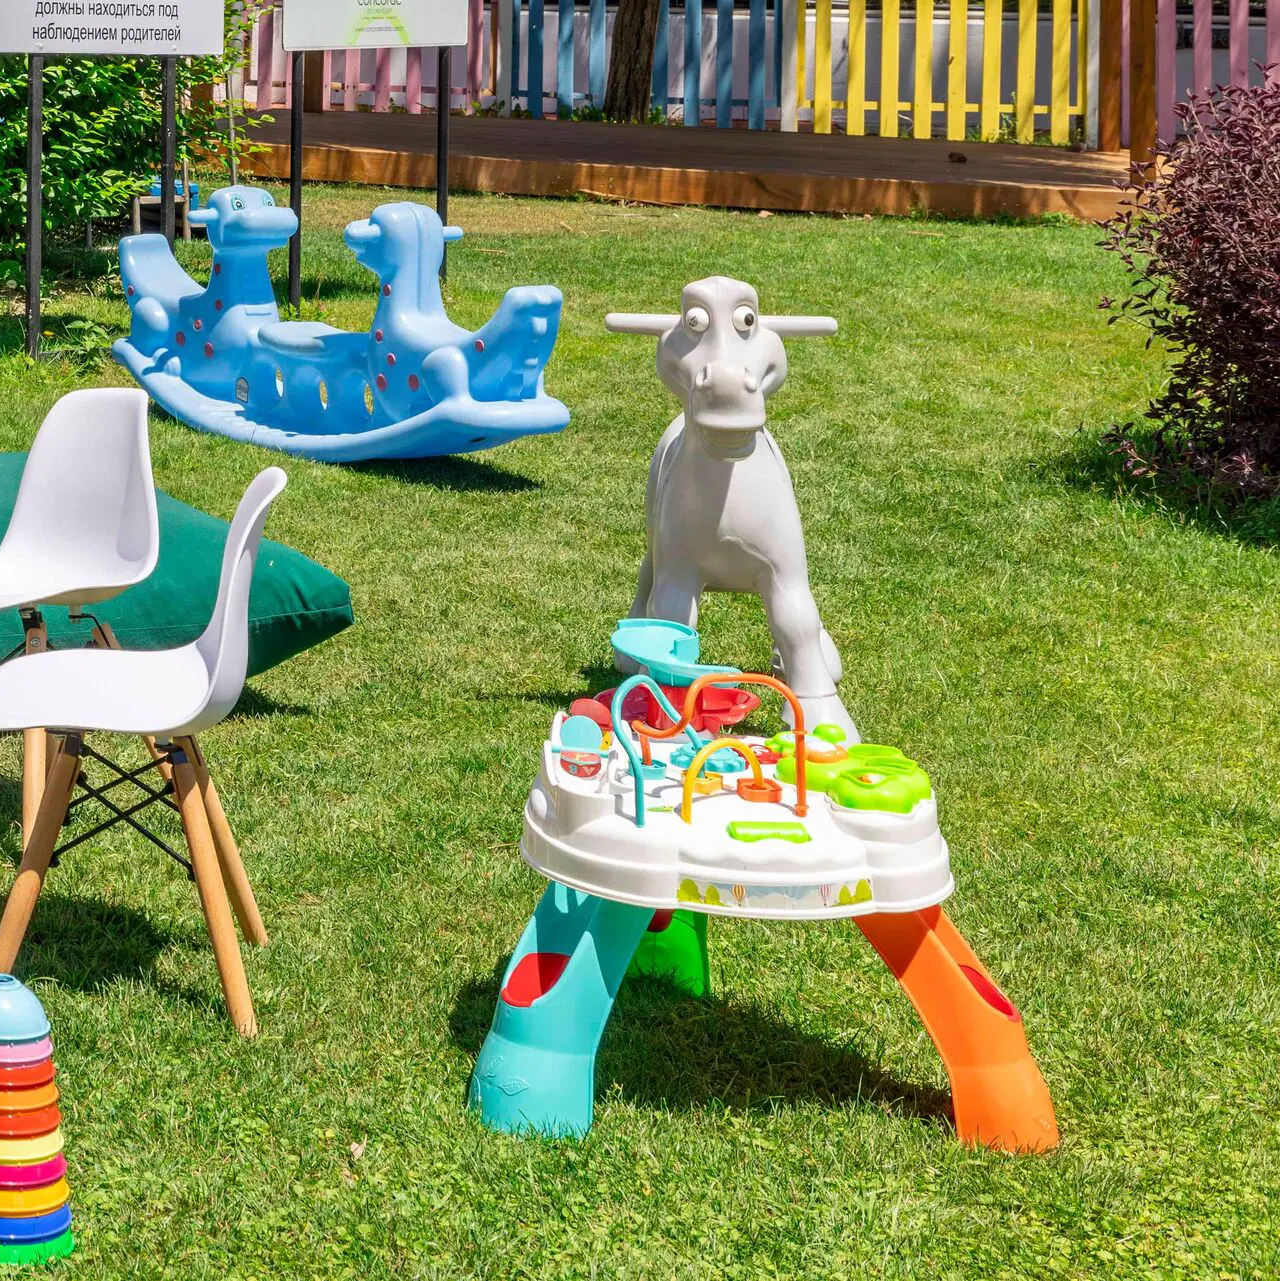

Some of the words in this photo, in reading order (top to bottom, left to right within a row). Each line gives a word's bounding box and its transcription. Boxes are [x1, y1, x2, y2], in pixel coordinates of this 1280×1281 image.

[35, 1, 85, 17] должны
[88, 2, 155, 18] находиться
[158, 3, 178, 18] под
[32, 22, 118, 42] наблюдением
[121, 25, 181, 44] родителей
